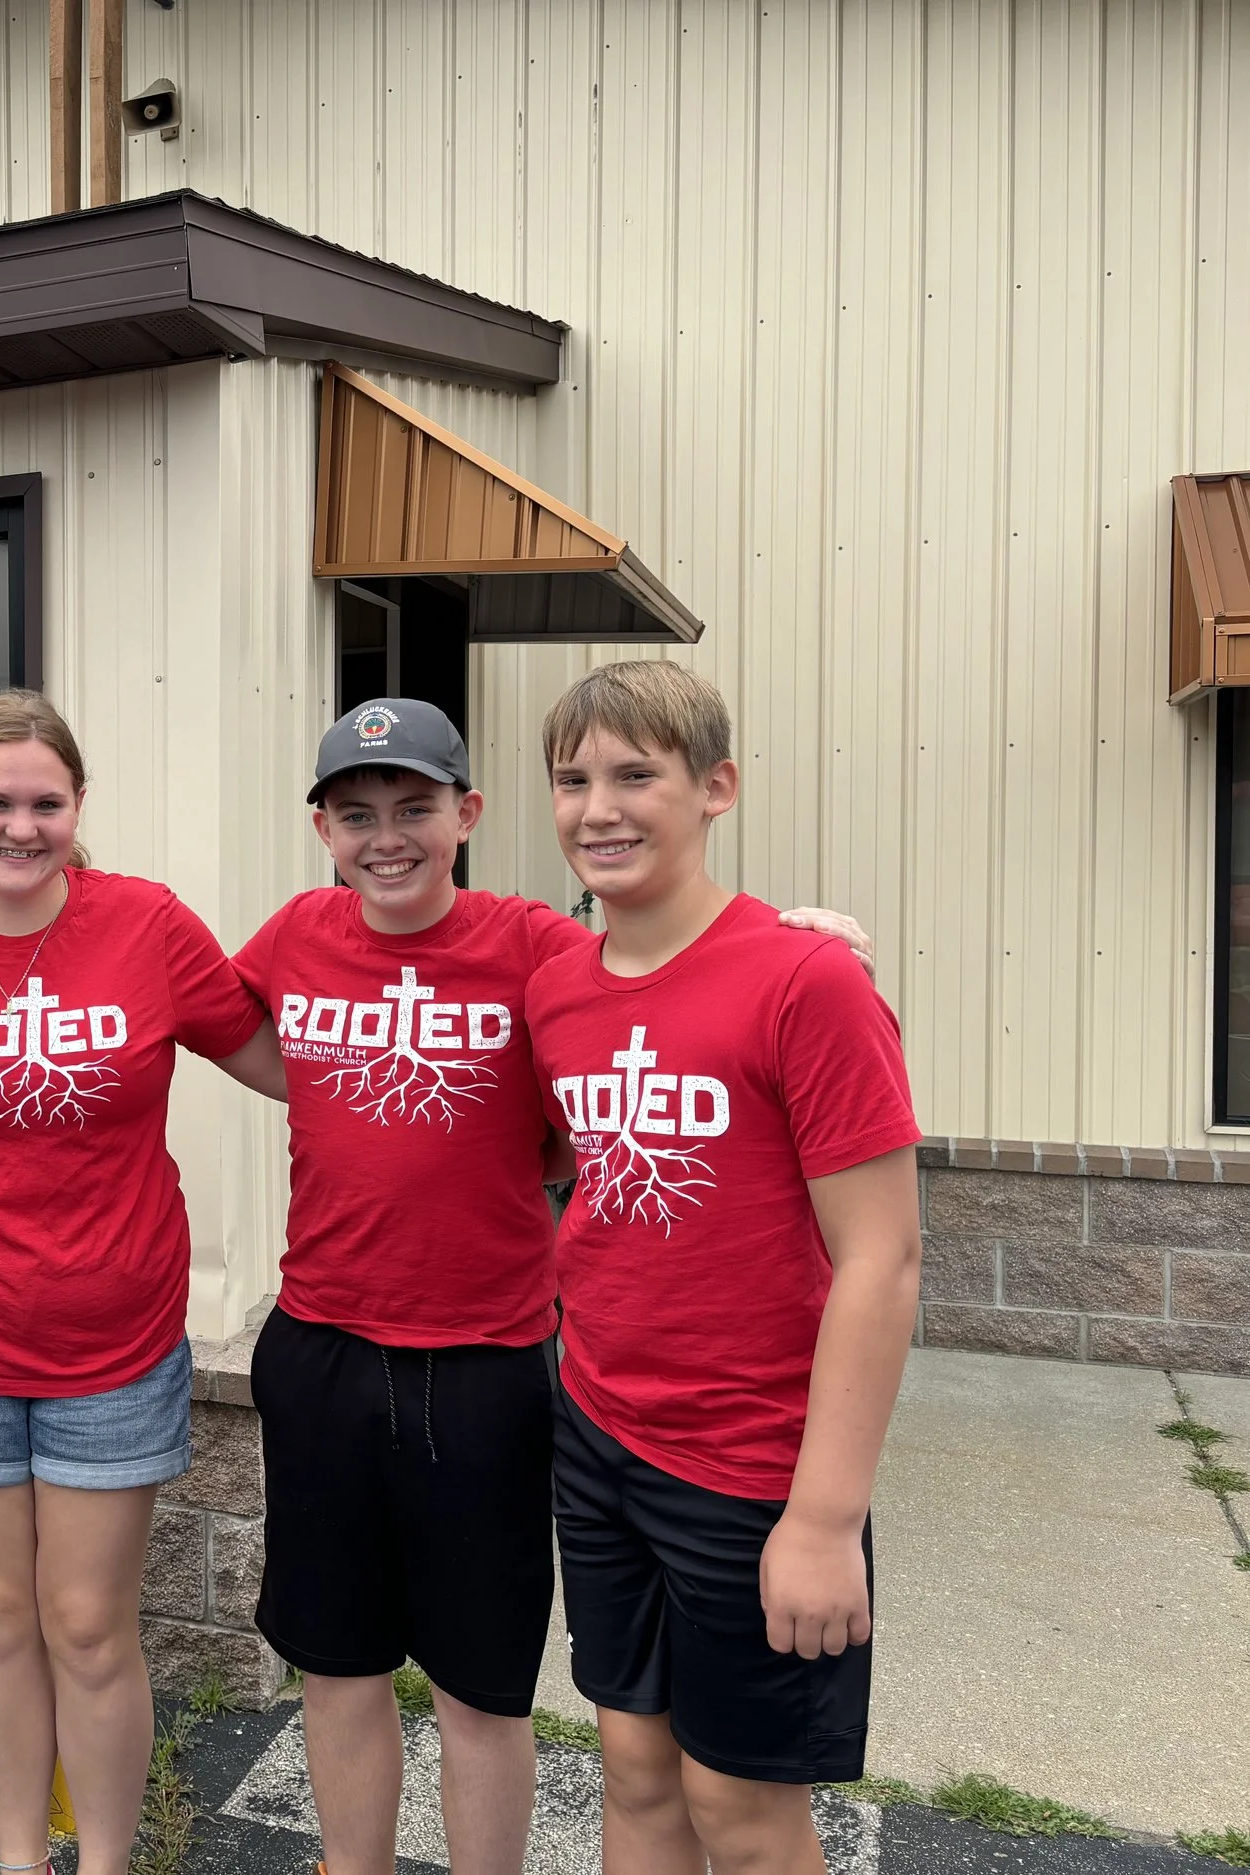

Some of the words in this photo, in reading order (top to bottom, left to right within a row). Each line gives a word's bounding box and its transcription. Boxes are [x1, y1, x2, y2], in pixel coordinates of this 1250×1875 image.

[360, 739, 389, 748] FARMS
[279, 966, 511, 1054] ROOTED
[334, 1057, 367, 1065] CHURCH
[552, 1025, 731, 1137] OOTED
